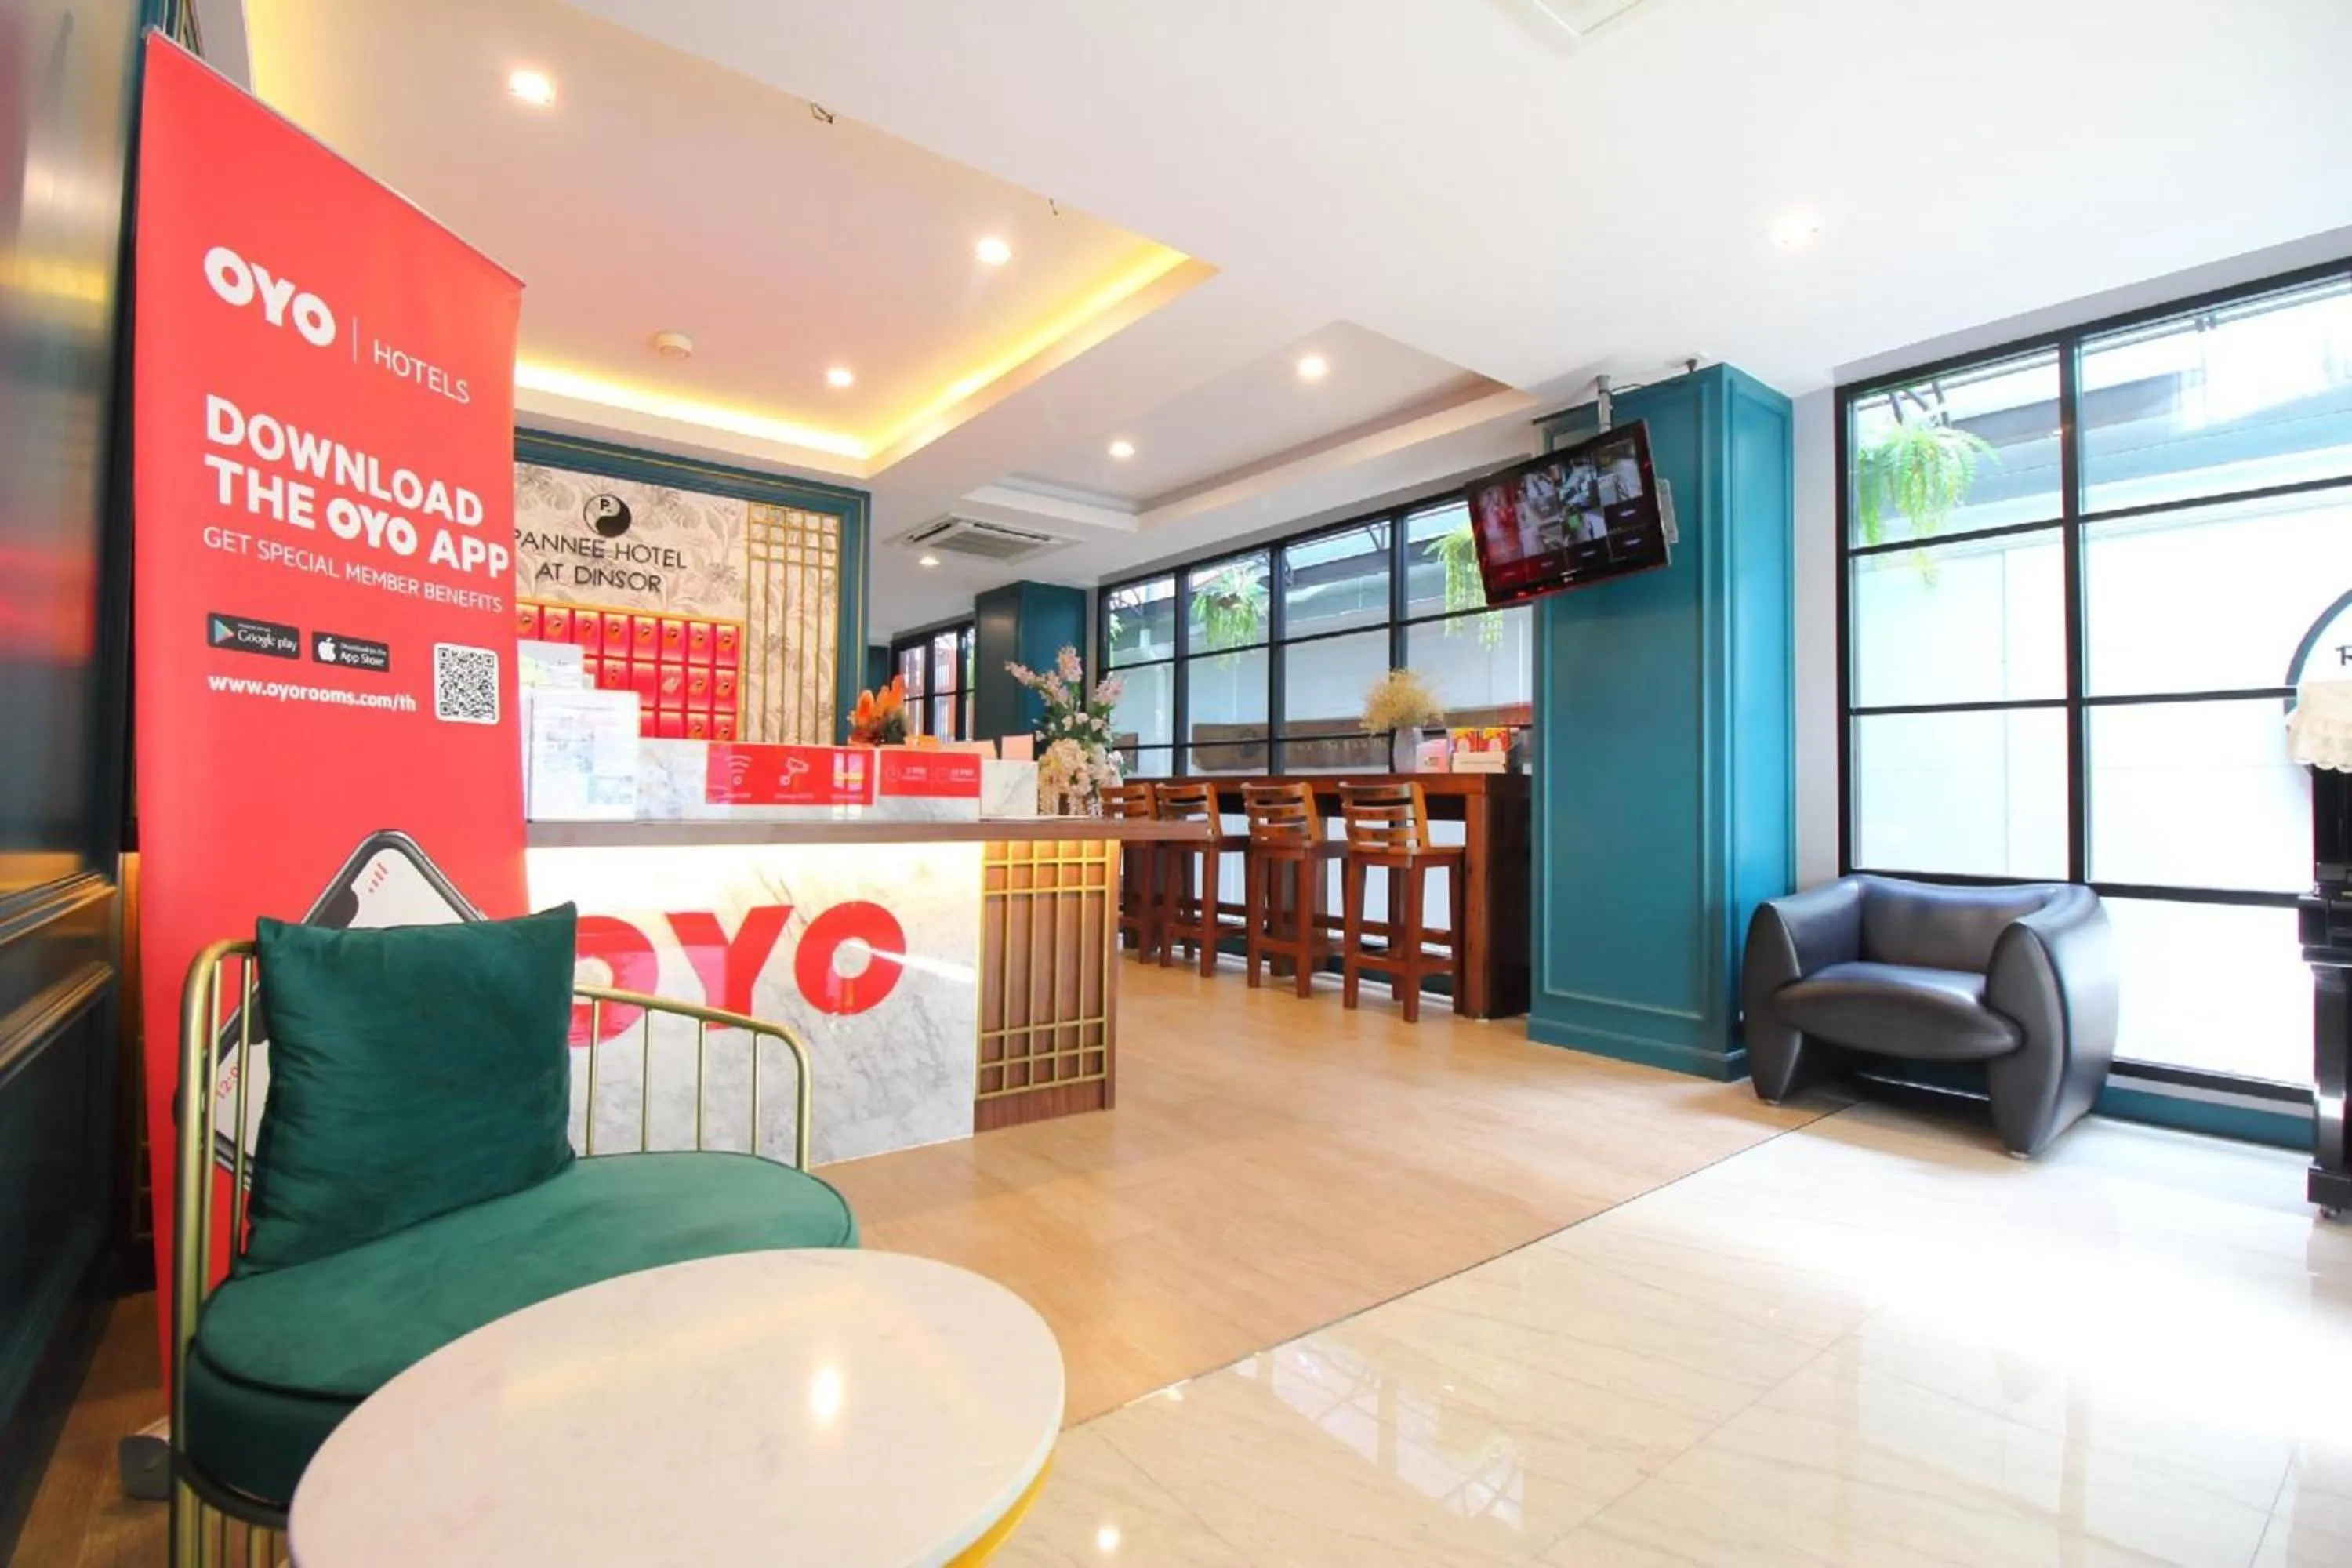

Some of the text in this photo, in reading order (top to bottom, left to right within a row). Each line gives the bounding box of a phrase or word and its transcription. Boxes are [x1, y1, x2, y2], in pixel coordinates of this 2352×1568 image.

[204, 246, 470, 405] OYO HOTELS
[206, 394, 484, 527] DOWNLOAD
[205, 453, 510, 579] THE OYO APP
[203, 526, 504, 613] GET SPECIAL MEMBER BENEFITS
[535, 562, 662, 593] AT DINSOR
[615, 543, 688, 569] HOTEL
[238, 629, 276, 648] Google
[340, 651, 385, 666] App Store
[207, 675, 417, 712] www.oyorooms.com/th
[570, 901, 906, 1047] OYO
